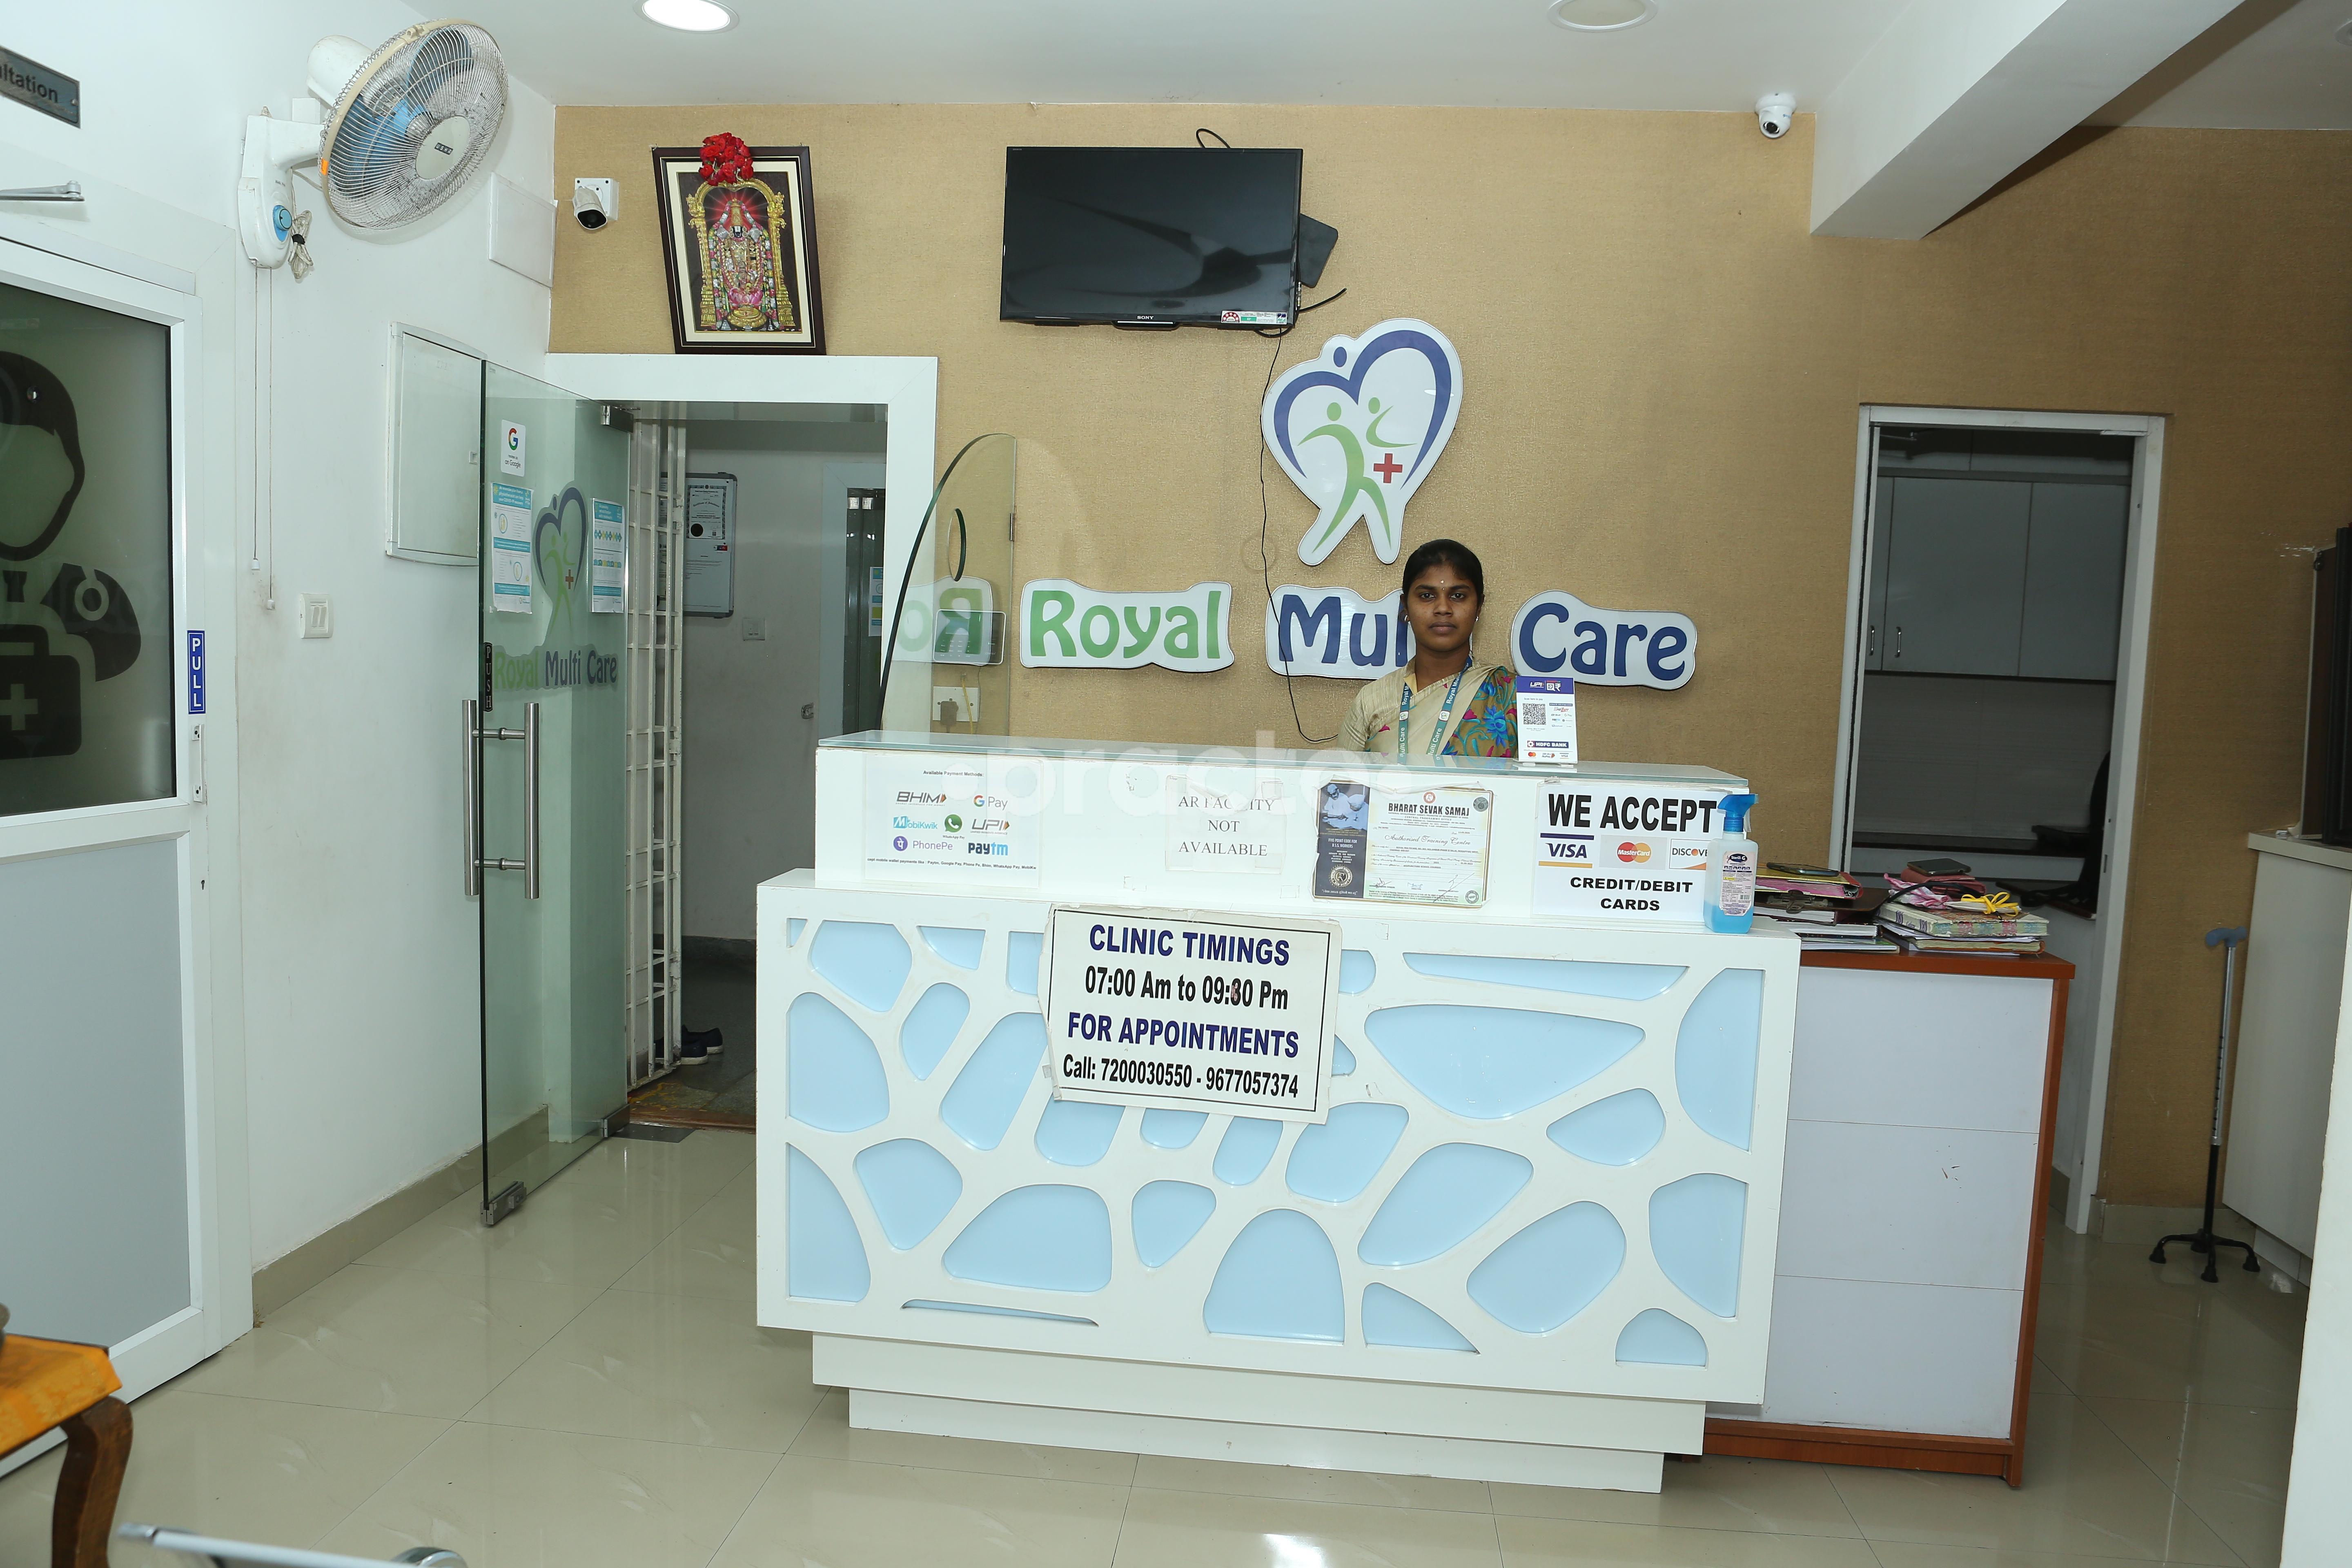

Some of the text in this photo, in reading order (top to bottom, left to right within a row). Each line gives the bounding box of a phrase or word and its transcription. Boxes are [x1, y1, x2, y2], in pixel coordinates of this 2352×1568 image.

[508, 428, 519, 450] G
[510, 460, 521, 468] Google
[1030, 590, 1686, 680] Royal Mul Care
[192, 637, 202, 707] PULL
[495, 650, 617, 689] Royal Multi Care
[1446, 688, 1456, 704] Royal
[1432, 728, 1442, 743] Care
[896, 791, 941, 804] BHIM
[973, 795, 1008, 811] G Pay
[1178, 796, 1275, 811] AR FACITY
[1388, 803, 1470, 816] BHARAT SEVAK SAMAJ
[1548, 793, 1717, 833] WE ACCEPT
[893, 816, 938, 829] MobiKwik
[971, 819, 1004, 831] UPI
[1207, 820, 1240, 832] NOT
[913, 840, 953, 850] PhonePe
[1385, 833, 1471, 846] Authorised Training Centre
[1179, 841, 1268, 856] AVAILABLE
[1545, 842, 1588, 858] VISA
[1617, 849, 1650, 857] MasterCard
[1672, 848, 1708, 857] DISCOVE
[1570, 877, 1693, 893] CREDIT/DEBIT
[1600, 898, 1660, 911] CARDS
[1089, 924, 1290, 966] CLINIC TIMINGS
[1085, 966, 1135, 997] 07:00
[1140, 971, 1171, 1000] Am
[1178, 974, 1195, 1002] to
[1259, 980, 1288, 1009] Pm
[1068, 1012, 1299, 1058] FOR APPOINTMENTS
[1063, 1054, 1096, 1080] Call:
[1101, 1058, 1192, 1088] 7200030550
[1206, 1067, 1298, 1098] 9677057374
